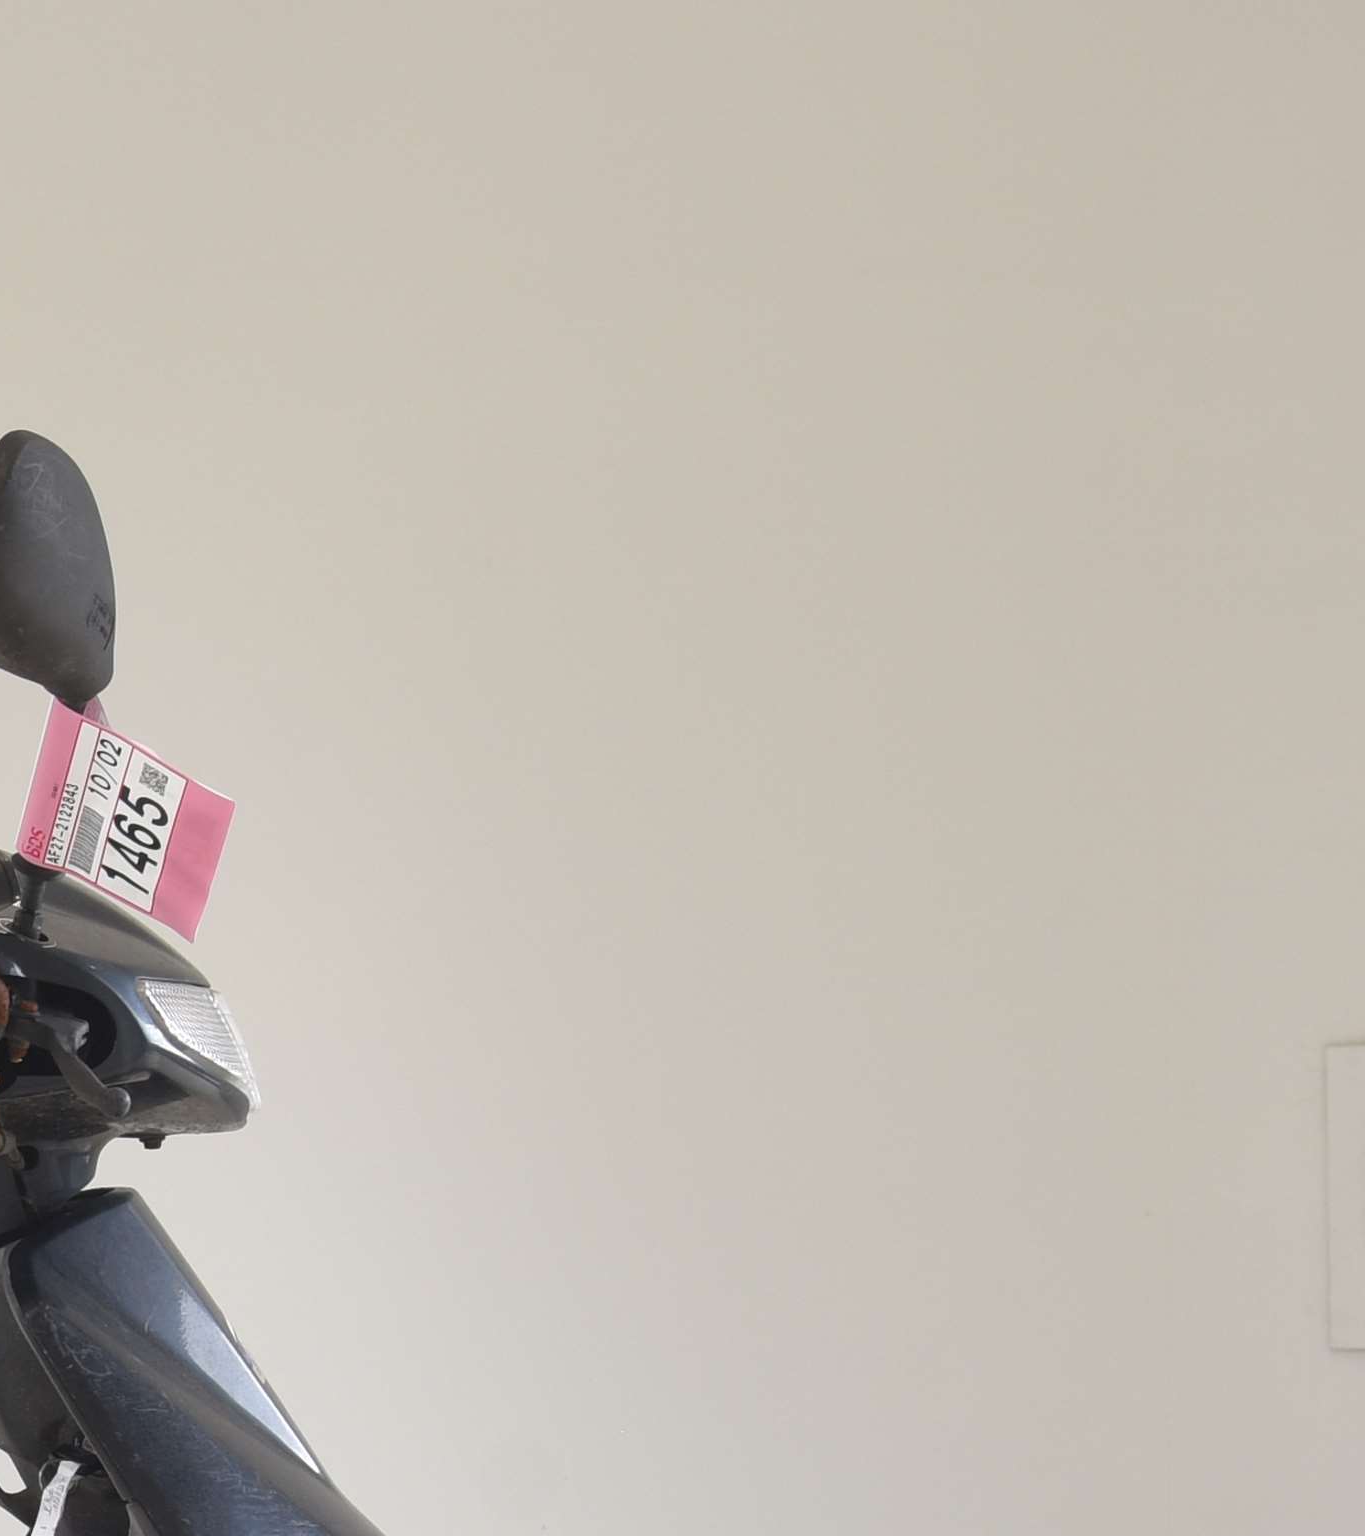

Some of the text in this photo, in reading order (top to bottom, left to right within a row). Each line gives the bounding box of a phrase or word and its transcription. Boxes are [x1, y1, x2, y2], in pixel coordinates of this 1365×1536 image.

[87, 738, 122, 801] 10/02
[46, 783, 79, 864] AF27-2122843
[101, 784, 169, 895] 1465
